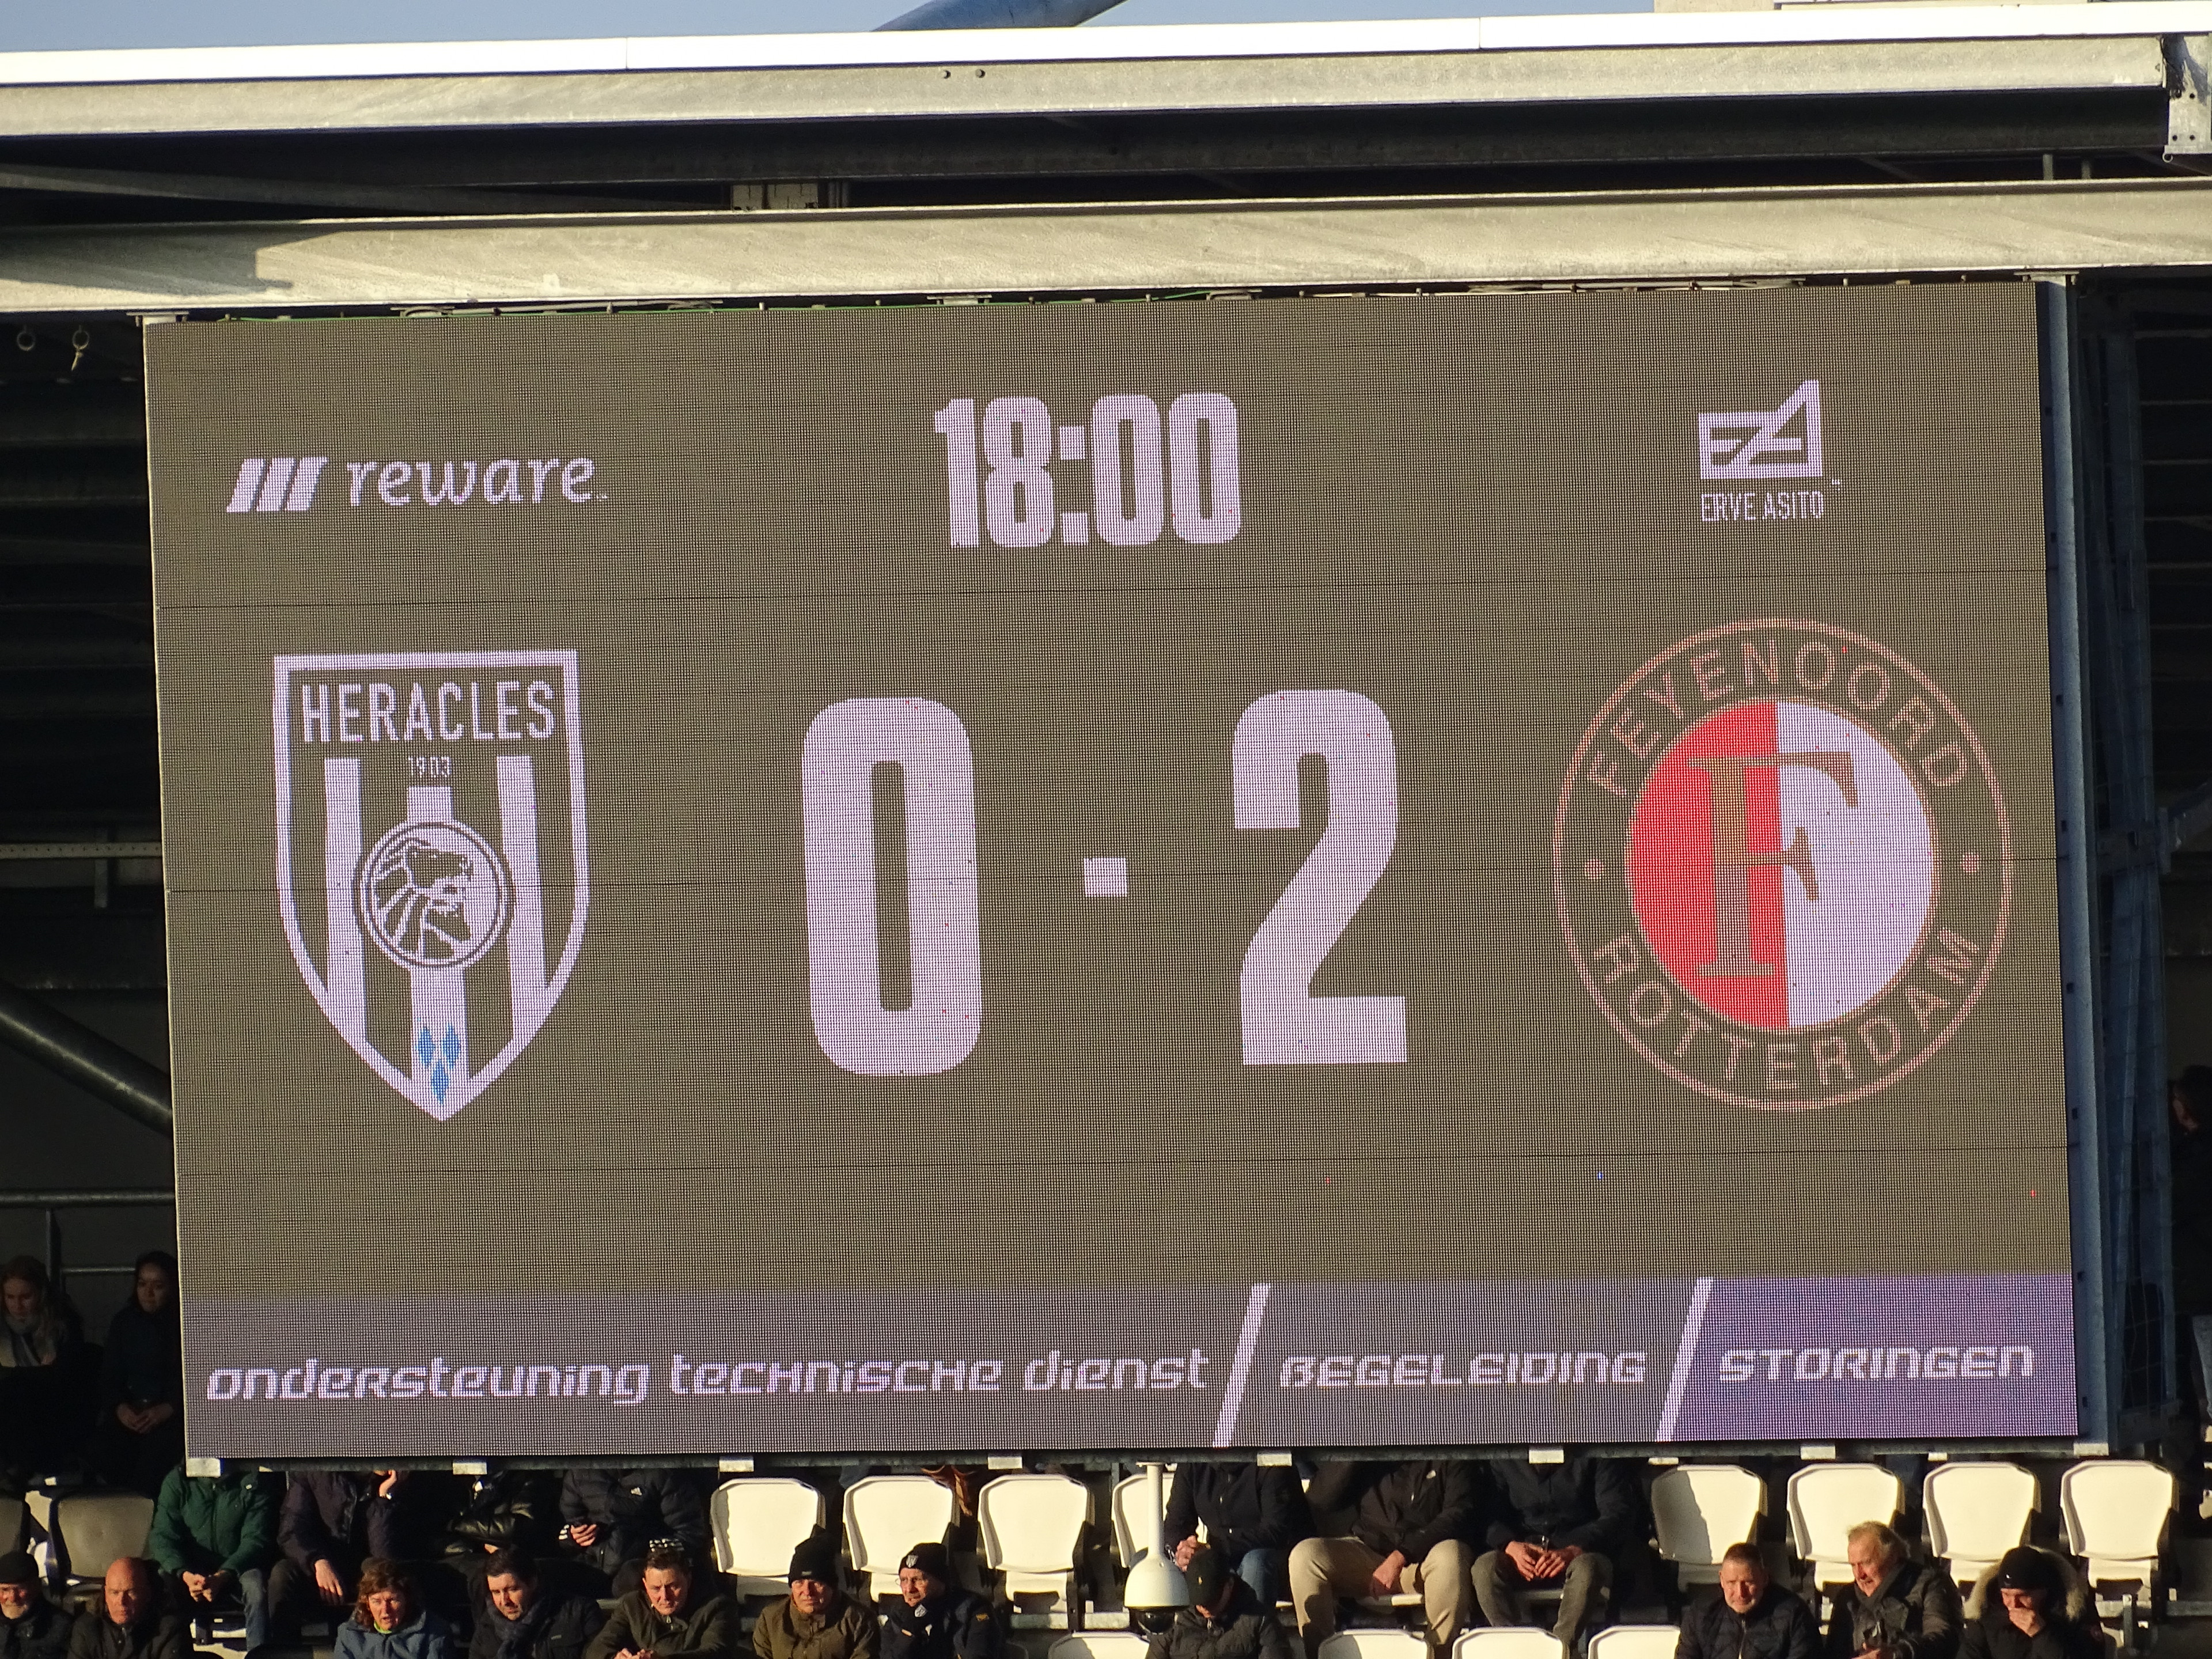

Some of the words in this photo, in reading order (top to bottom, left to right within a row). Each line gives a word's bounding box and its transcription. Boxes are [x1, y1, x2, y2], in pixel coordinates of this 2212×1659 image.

[934, 392, 1243, 548] 18:00
[1701, 492, 1756, 521] ERVE
[1762, 491, 1824, 520] ASITO
[302, 681, 556, 743] HERACLES
[1588, 639, 1968, 798] FEYENOORD
[407, 755, 453, 778] 1903
[801, 697, 982, 1076] 0
[1233, 690, 1408, 1066] 2
[1688, 751, 1858, 978] F
[1592, 929, 1981, 1090] ROTTERDAM
[1024, 1349, 1209, 1391] dienst
[1279, 1351, 1646, 1388] BEGELEIDING
[1719, 1346, 2033, 1381] STORINGEN
